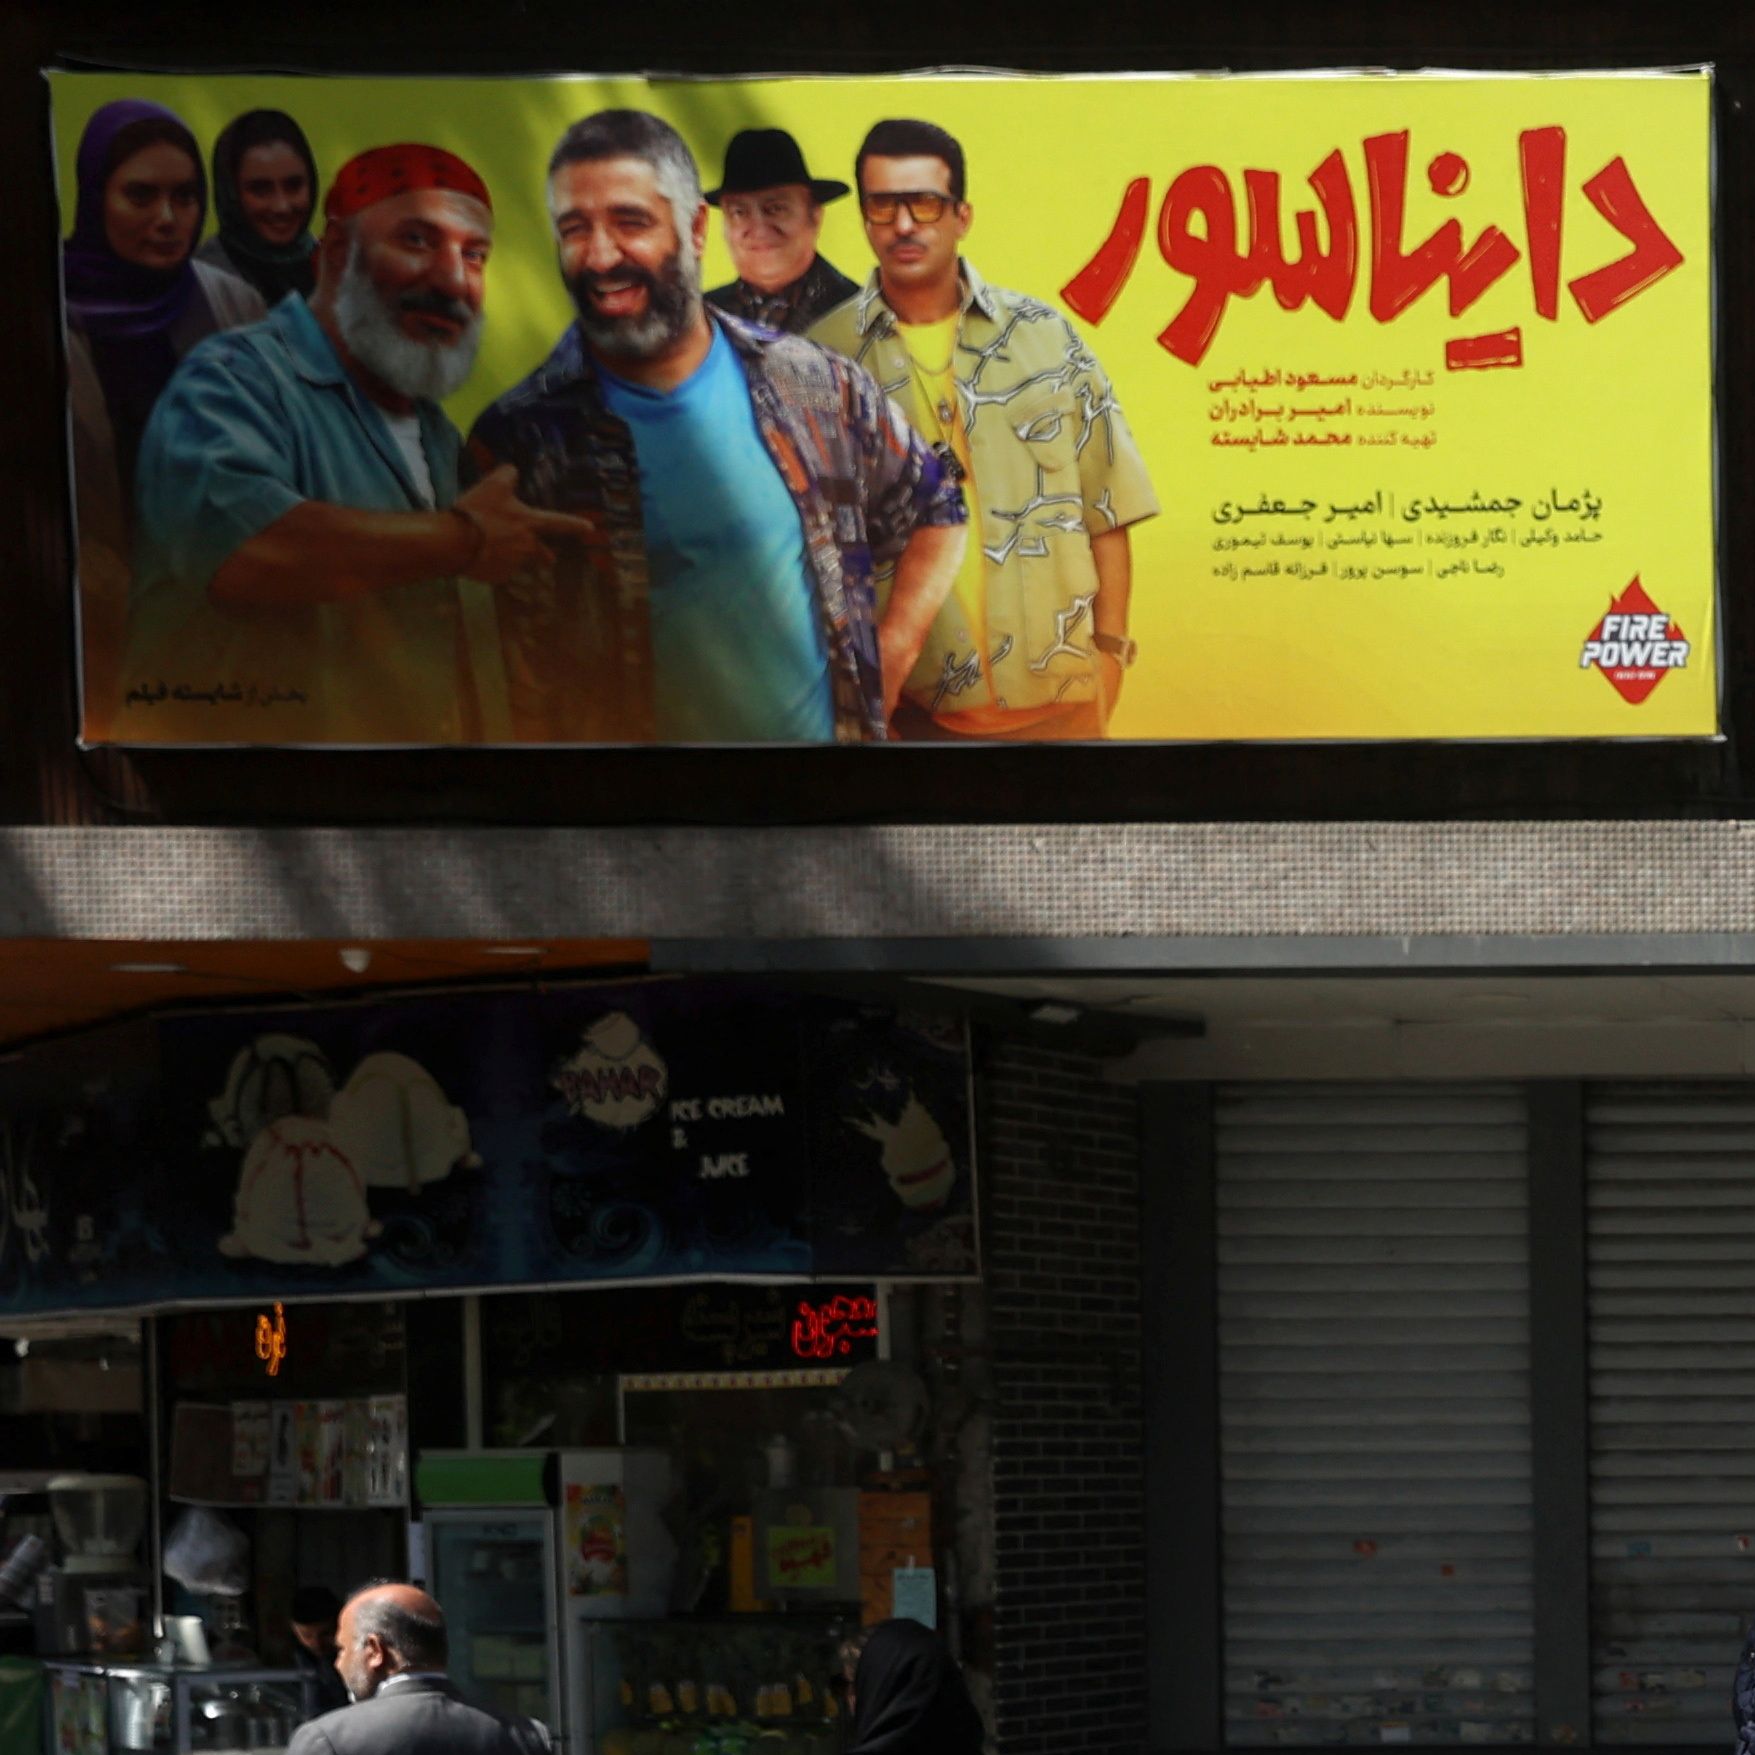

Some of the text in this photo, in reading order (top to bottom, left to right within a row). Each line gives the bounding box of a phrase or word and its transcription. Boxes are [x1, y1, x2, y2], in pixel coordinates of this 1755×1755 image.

[1284, 372, 1358, 392] مسعود
[1361, 367, 1435, 391] کارگردان
[1287, 396, 1352, 422] امیر
[1357, 402, 1435, 421] نویسنده
[1210, 427, 1290, 452] شایسته
[1292, 431, 1353, 447] محمد
[1212, 486, 1603, 524] پژمان جمشیدی امیر جعفری
[1600, 613, 1669, 641] FIRE
[1580, 640, 1690, 668] POWER
[670, 1093, 786, 1121] ICE CREAM
[671, 1126, 688, 1151] &
